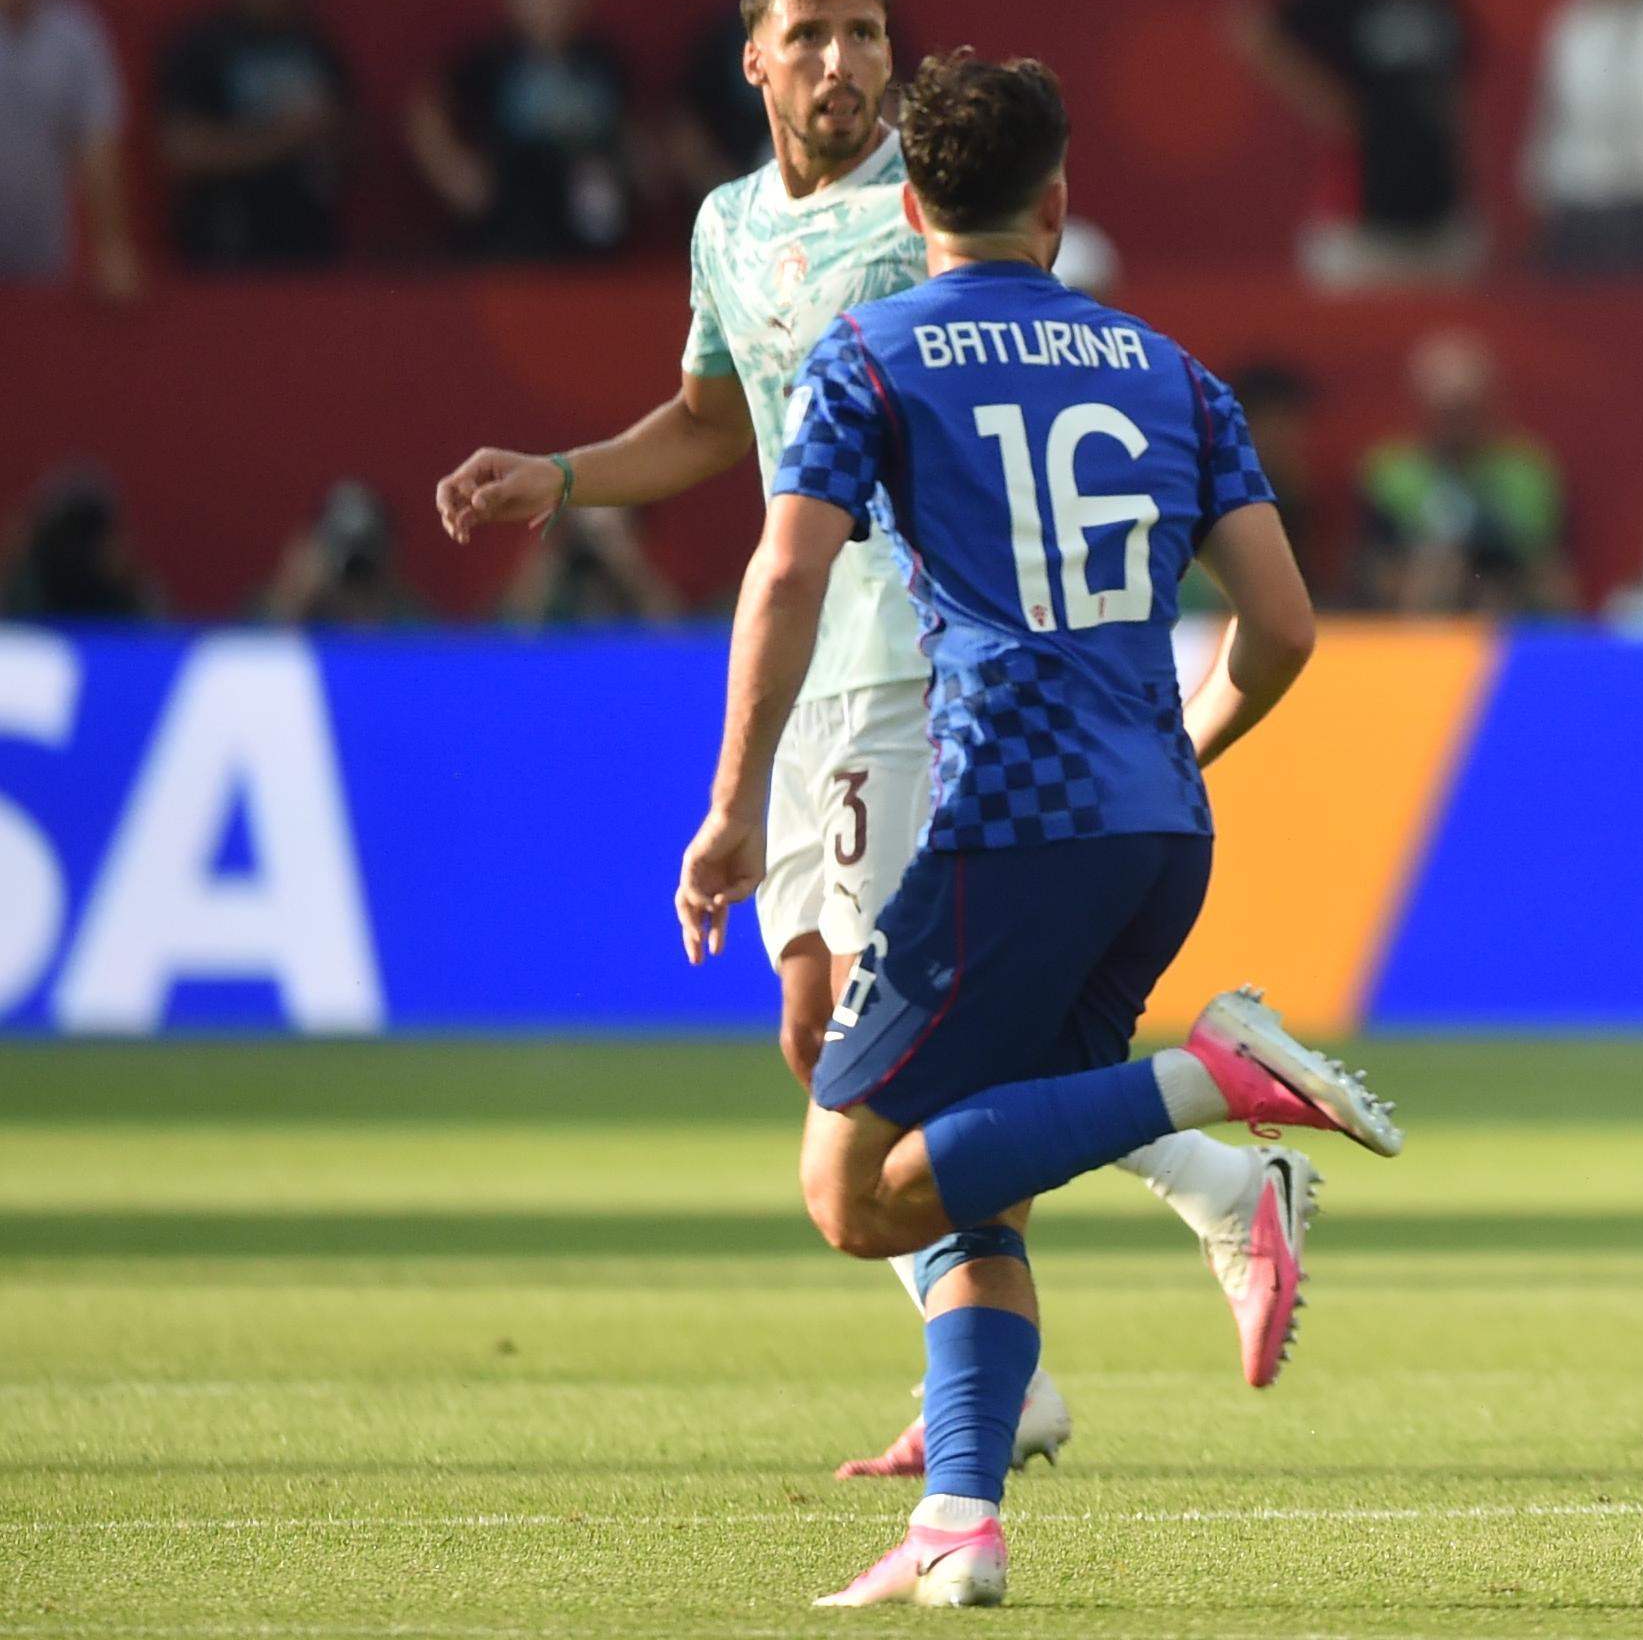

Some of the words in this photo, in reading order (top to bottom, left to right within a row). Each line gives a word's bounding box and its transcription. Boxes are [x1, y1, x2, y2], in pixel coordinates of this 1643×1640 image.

[913, 320, 1150, 371] BATURINA
[973, 402, 1159, 632] 16
[0, 626, 388, 1035] A
[833, 770, 870, 866] 3
